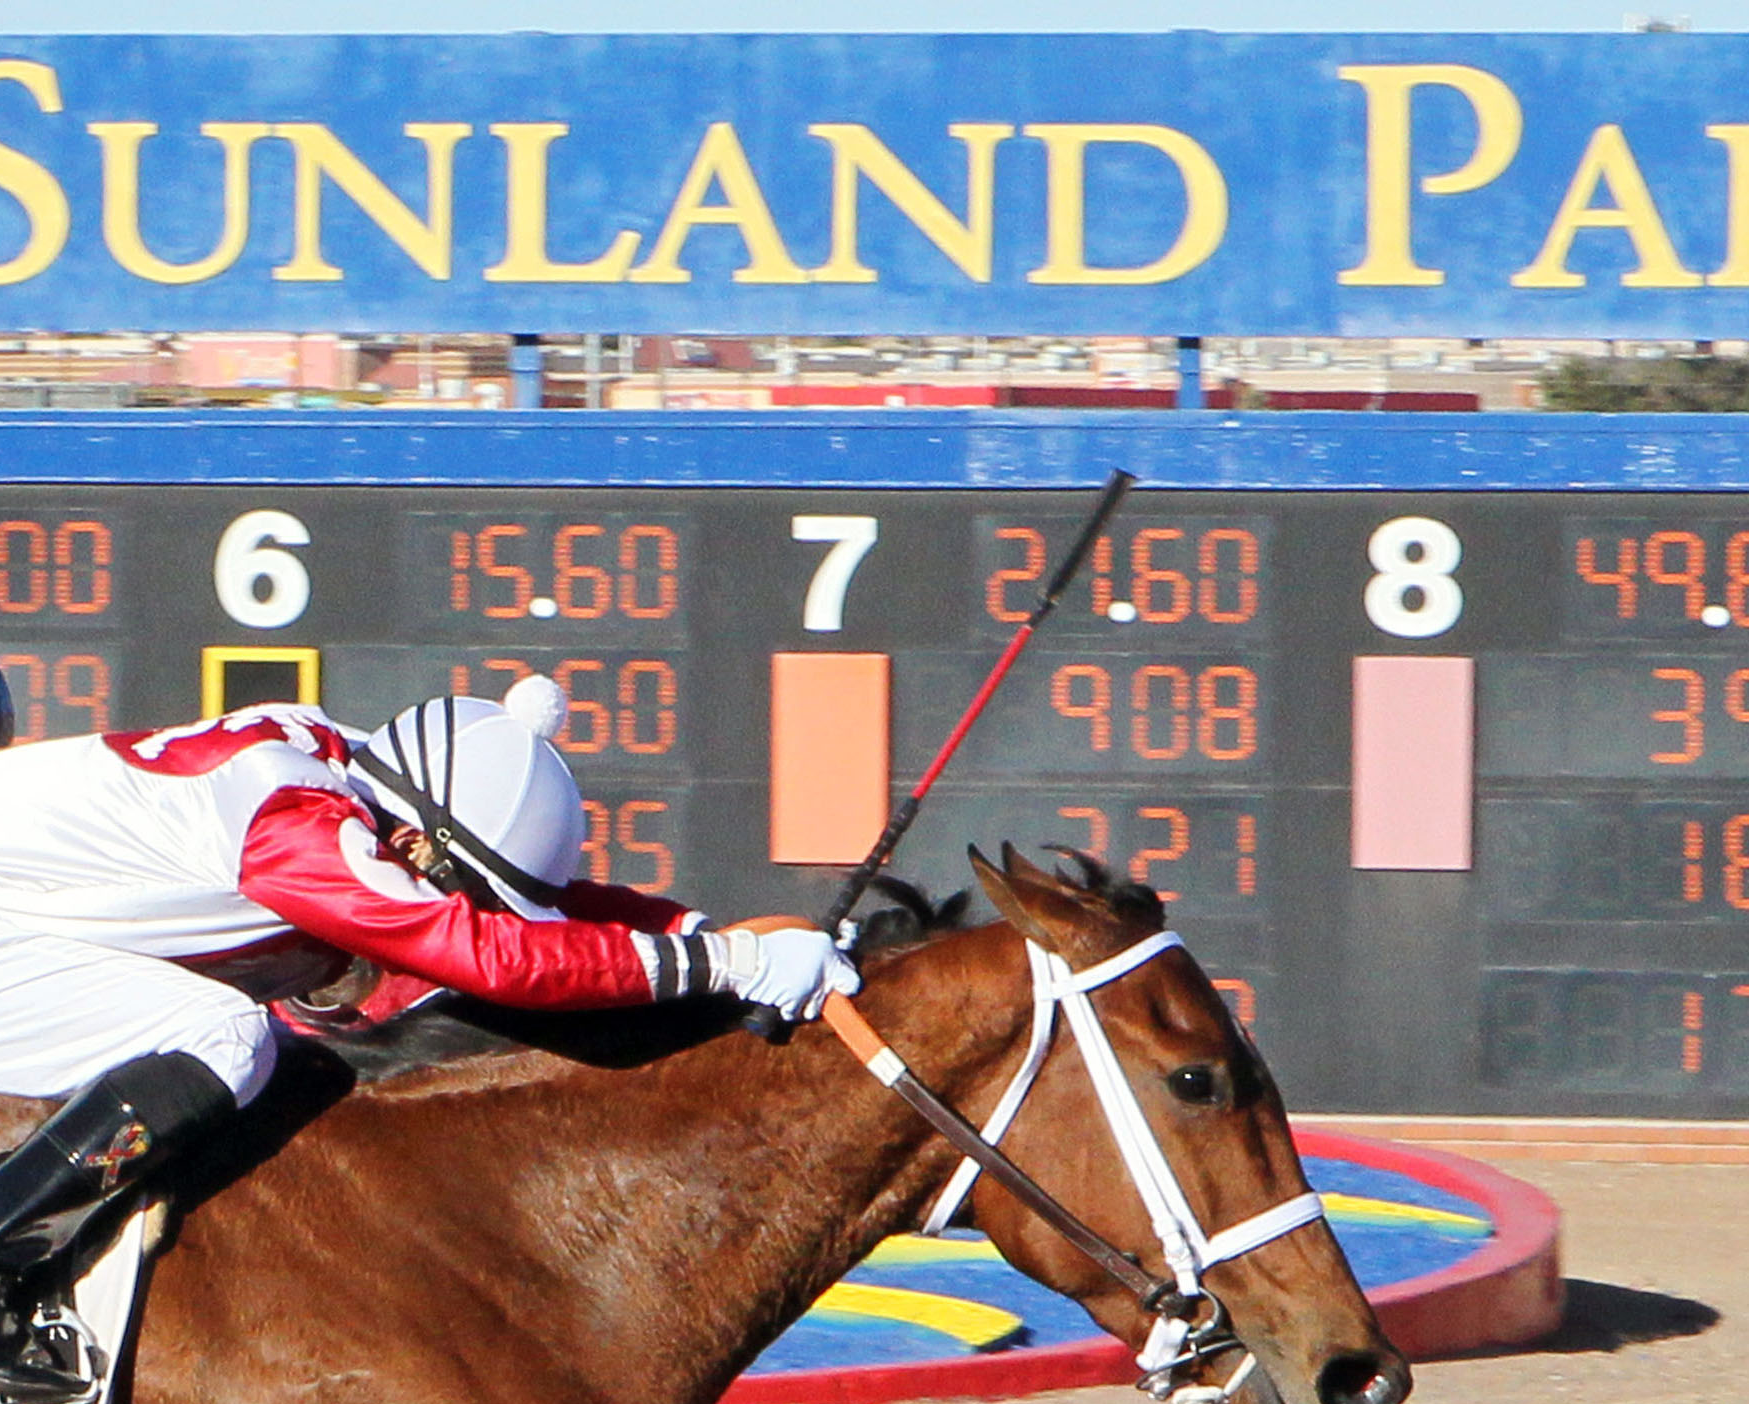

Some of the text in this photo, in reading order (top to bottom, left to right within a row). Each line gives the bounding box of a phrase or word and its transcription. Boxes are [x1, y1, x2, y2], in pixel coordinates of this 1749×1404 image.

[214, 510, 311, 628] 6
[450, 523, 679, 620] 15.60
[791, 516, 879, 631] 7
[985, 526, 1260, 625] 21.60
[1364, 517, 1464, 638] 8
[1050, 663, 1259, 761] 908
